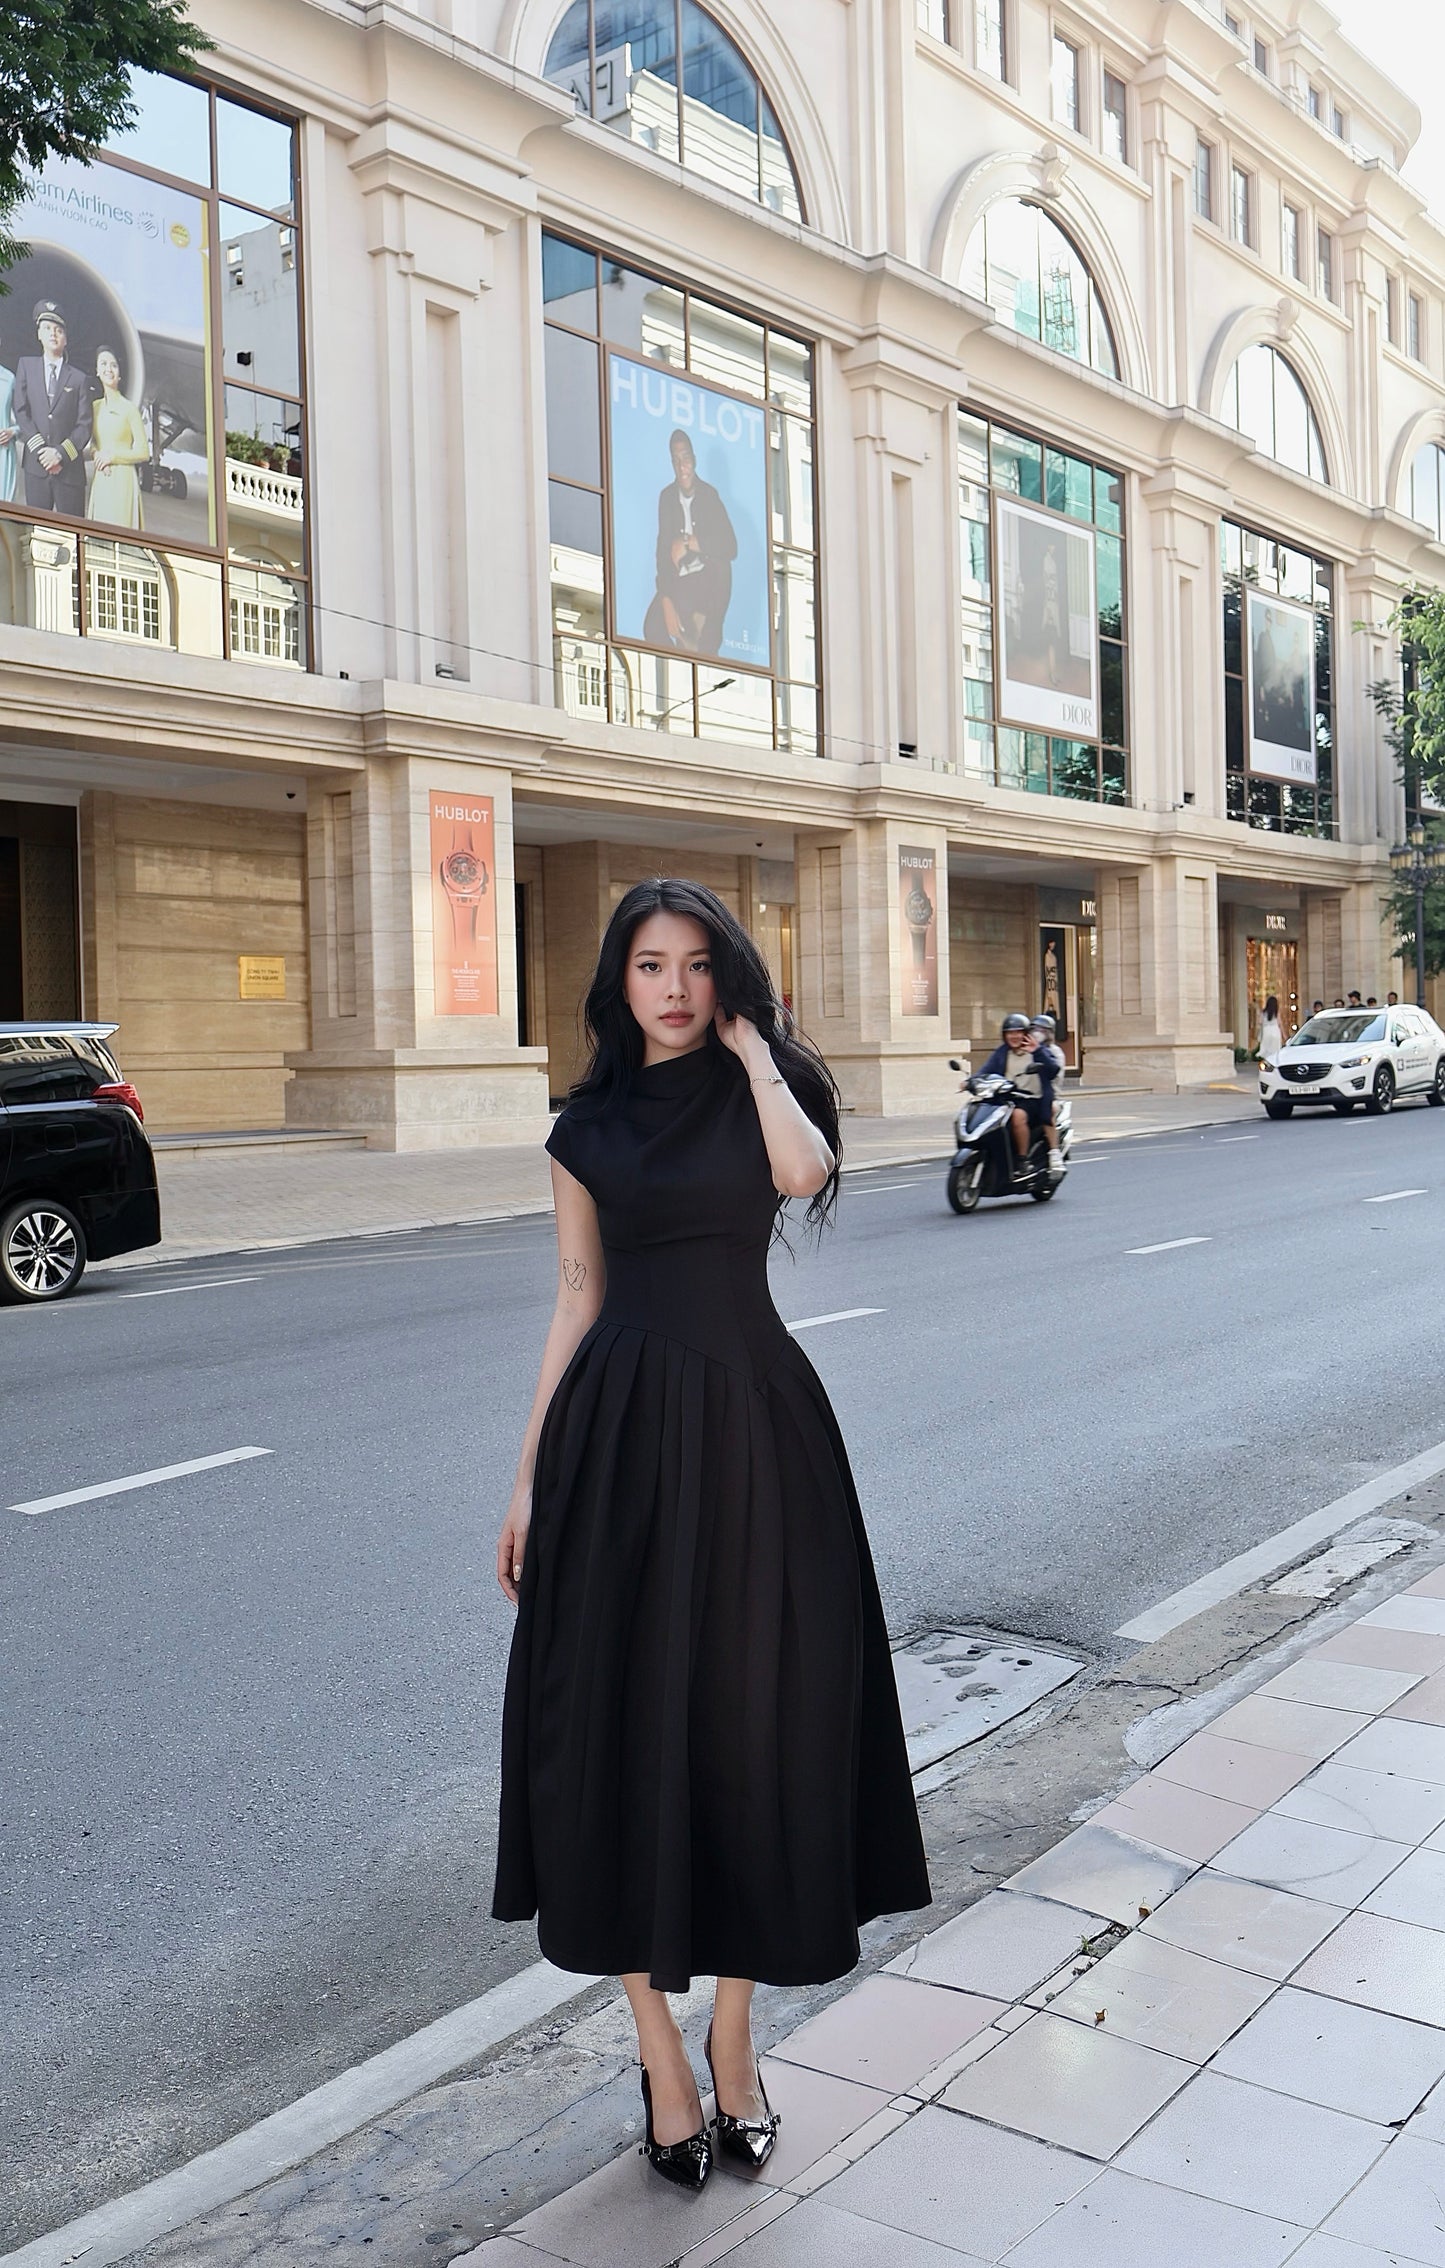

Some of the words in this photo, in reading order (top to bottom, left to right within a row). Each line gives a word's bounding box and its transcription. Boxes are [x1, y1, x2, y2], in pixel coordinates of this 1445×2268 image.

[610, 360, 762, 449] HUBLOT
[1062, 703, 1092, 727] DIOR
[1290, 755, 1313, 775] DIOR
[434, 804, 489, 823] HUBLOT
[900, 856, 933, 870] HUBLOT
[1265, 914, 1286, 930] DIOR
